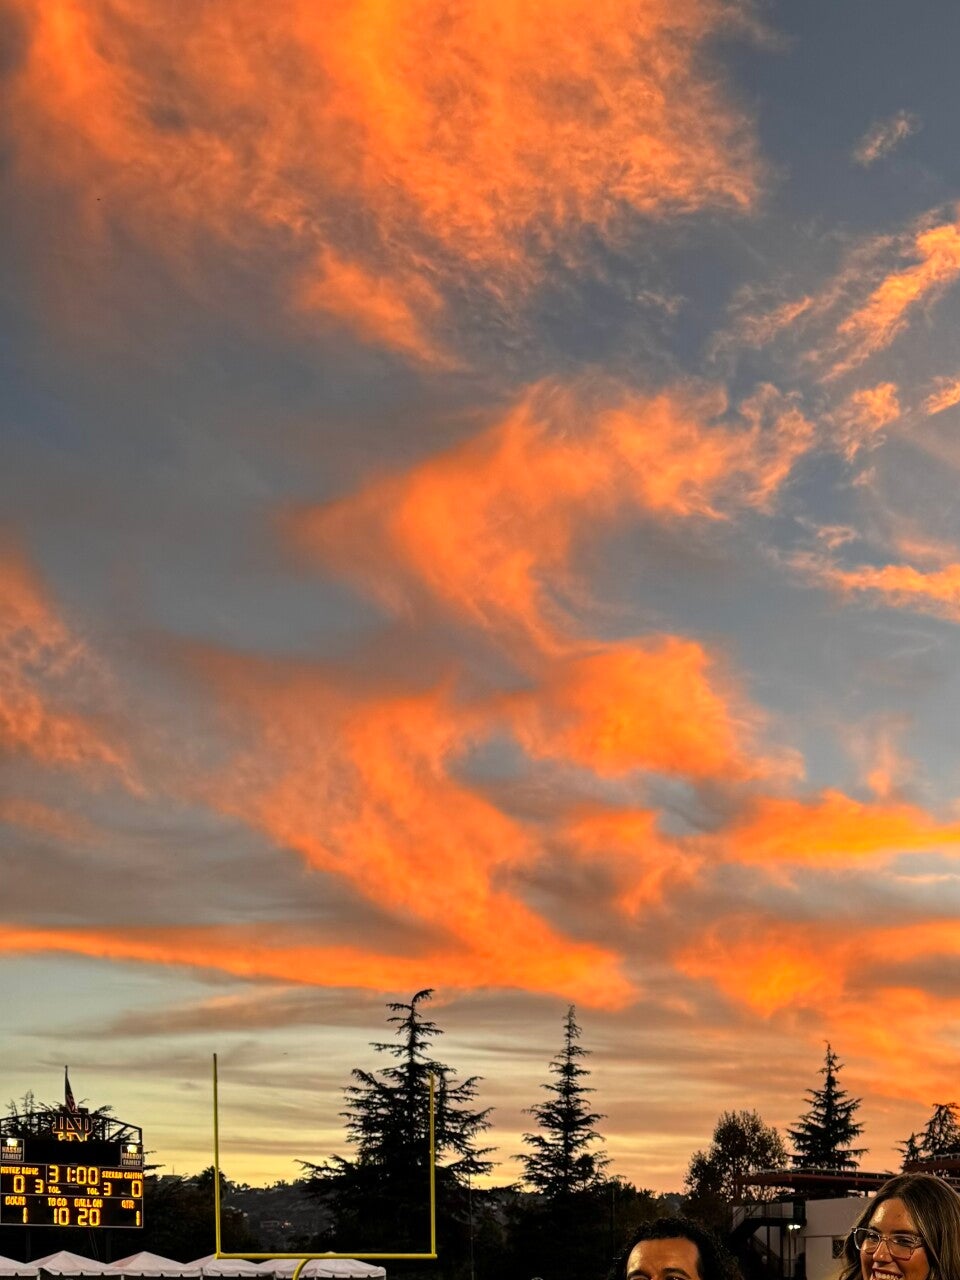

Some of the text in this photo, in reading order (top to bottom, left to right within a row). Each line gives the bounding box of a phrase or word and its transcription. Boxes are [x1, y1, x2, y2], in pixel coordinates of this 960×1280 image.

[13, 1175, 25, 1193] 0
[35, 1179, 44, 1194] 3
[103, 1182, 112, 1196] 3
[131, 1180, 142, 1198] 0
[22, 1207, 28, 1223] 1
[53, 1207, 69, 1225] 10
[78, 1208, 100, 1226] 20
[136, 1210, 141, 1226] 1
